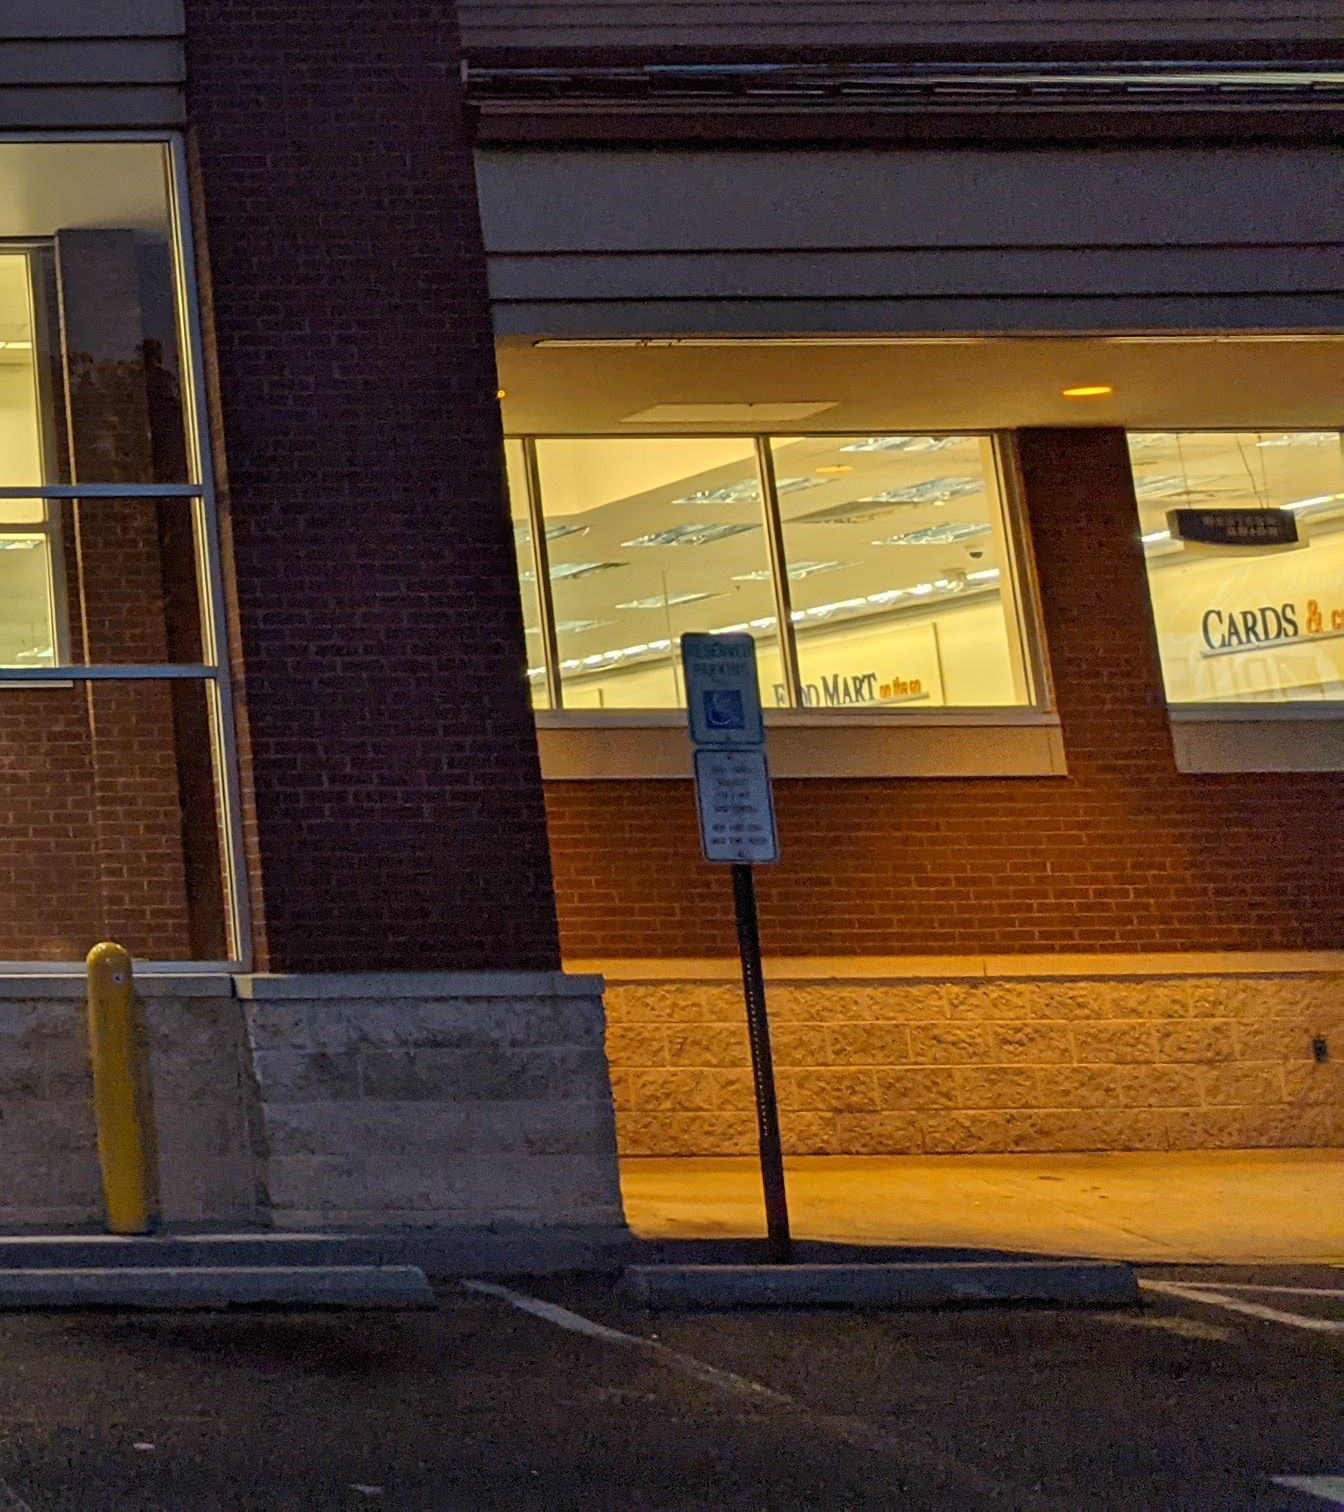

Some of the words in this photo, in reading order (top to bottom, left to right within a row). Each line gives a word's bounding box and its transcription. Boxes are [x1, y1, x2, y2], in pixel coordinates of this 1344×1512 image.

[1201, 602, 1299, 650] CARDS
[1305, 598, 1324, 634] &
[820, 672, 877, 707] MART
